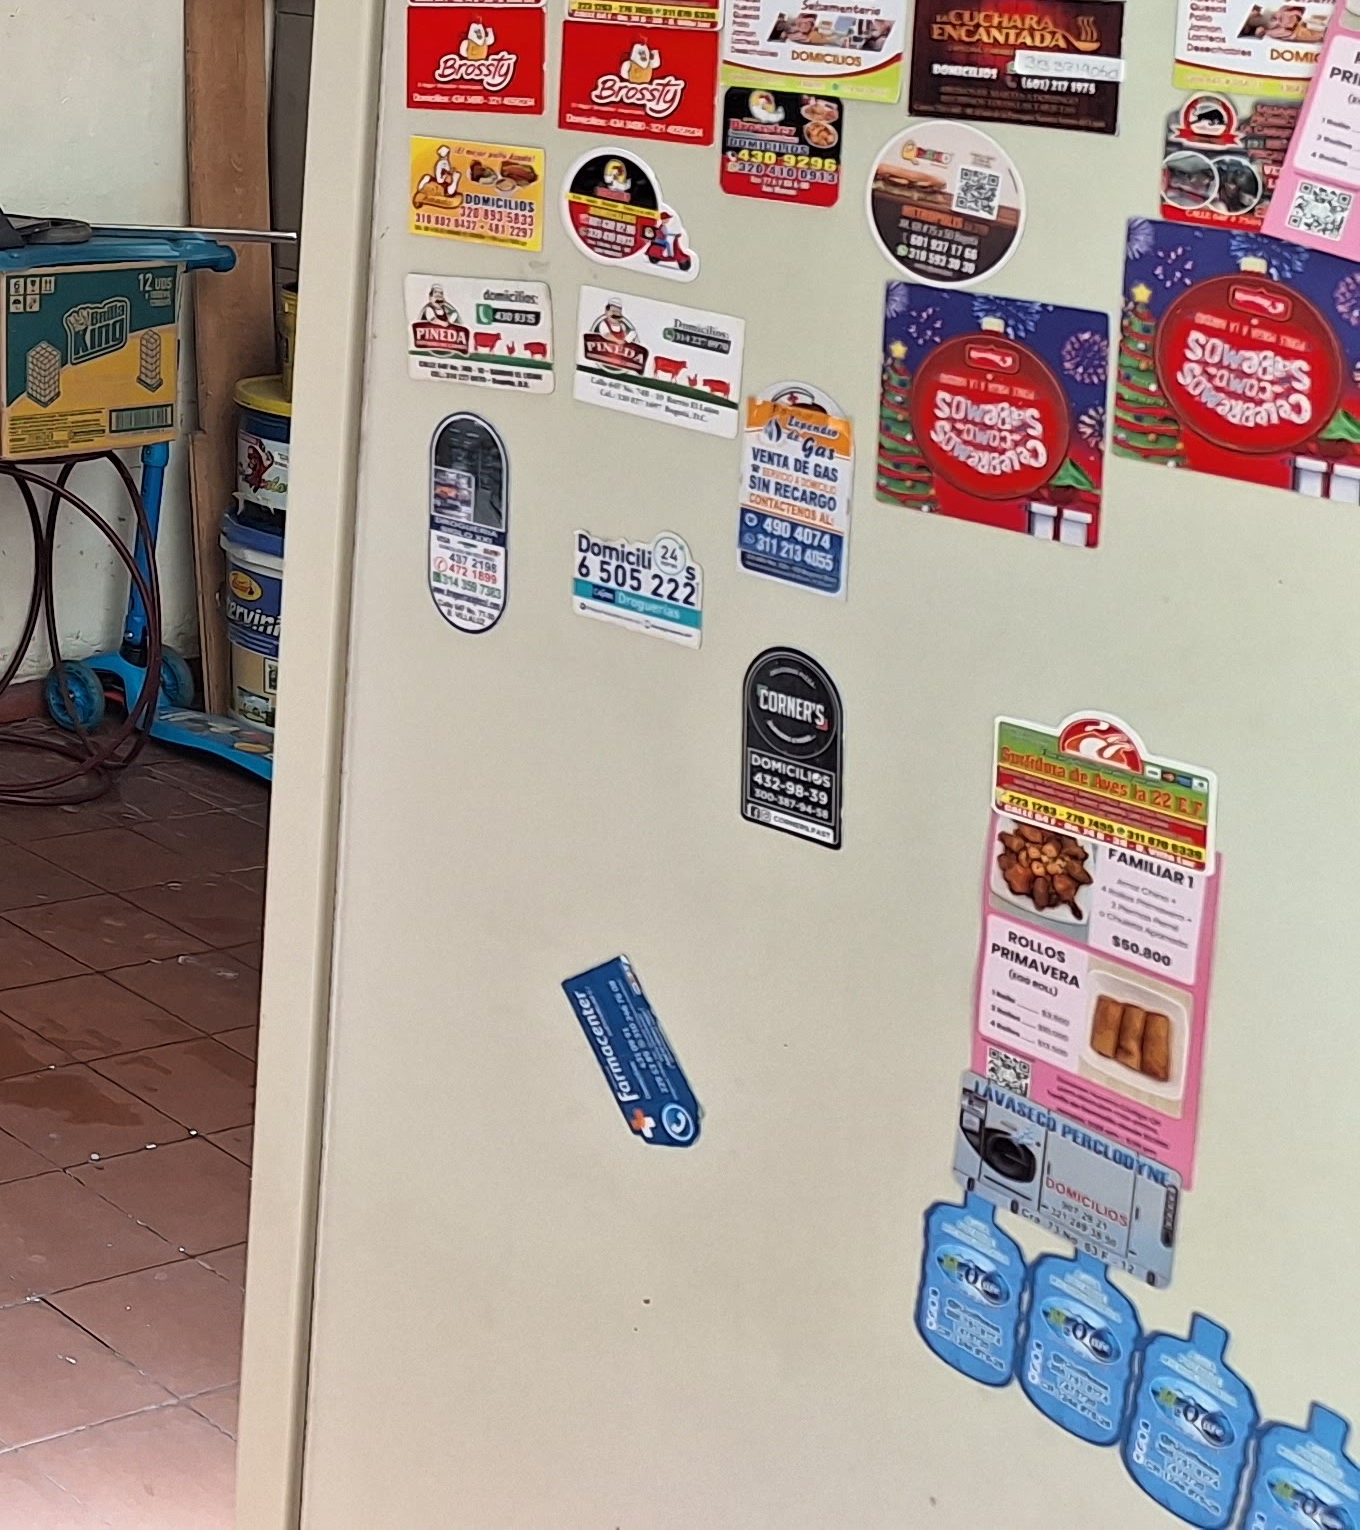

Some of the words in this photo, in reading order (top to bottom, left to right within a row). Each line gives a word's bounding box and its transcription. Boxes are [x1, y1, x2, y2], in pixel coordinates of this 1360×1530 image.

[948, 10, 1054, 30] CUCHARA
[932, 25, 1068, 48] ENCANTADA
[436, 52, 516, 90] Brossty
[792, 51, 861, 67] DOMICILIOS
[932, 64, 998, 79] DOMICILIOS
[592, 76, 685, 117] Brossty
[738, 150, 776, 164] 430
[784, 154, 836, 172] 9296
[738, 161, 764, 174] 320
[767, 165, 796, 178] 410
[799, 170, 837, 184] 0913
[460, 206, 479, 218] 320
[484, 209, 503, 221] 893
[507, 212, 534, 226] 5833
[465, 194, 534, 212] DOMICILIOS
[416, 213, 431, 224] 310
[488, 222, 505, 234] 481
[510, 226, 533, 238] 2297
[139, 274, 152, 291] 12
[416, 328, 467, 344] PINEDA
[587, 341, 644, 363] PINEDA
[802, 437, 835, 460] Gas
[751, 447, 789, 470] VENTA
[794, 458, 809, 475] DE
[814, 464, 838, 482] GAS
[749, 475, 770, 493] SIN
[774, 481, 837, 511] RECARGO
[749, 493, 817, 520] CONTACTENOS
[763, 517, 791, 538] 490
[794, 527, 830, 549] 4074
[449, 553, 467, 565] 437
[661, 545, 678, 562] 24
[756, 534, 777, 552] 311
[779, 540, 801, 561] 213
[804, 549, 833, 571] 4055
[449, 563, 471, 575] 472
[473, 570, 497, 584] 1899
[578, 556, 590, 577] 6
[600, 560, 641, 591] 505
[651, 574, 695, 606] 222
[759, 689, 825, 726] CORNER'S
[751, 754, 831, 788] DOMICILIOS
[753, 772, 828, 805] 432-98-39
[1070, 768, 1089, 785] de
[1094, 775, 1127, 796] Aves
[1134, 784, 1146, 802] la
[1150, 790, 1171, 807] 22
[1108, 848, 1185, 887] FAMILIAR
[1188, 876, 1194, 888] 1
[1008, 931, 1065, 963] ROLLOS
[1112, 935, 1171, 966] $50.800
[991, 943, 1080, 988] PRIMAVERA
[574, 990, 640, 1102] Farmacenter
[974, 1080, 1056, 1131] LAVASECO
[1061, 1124, 1169, 1187] PERCLODYNE
[1046, 1176, 1127, 1227] DOMICILIOS
